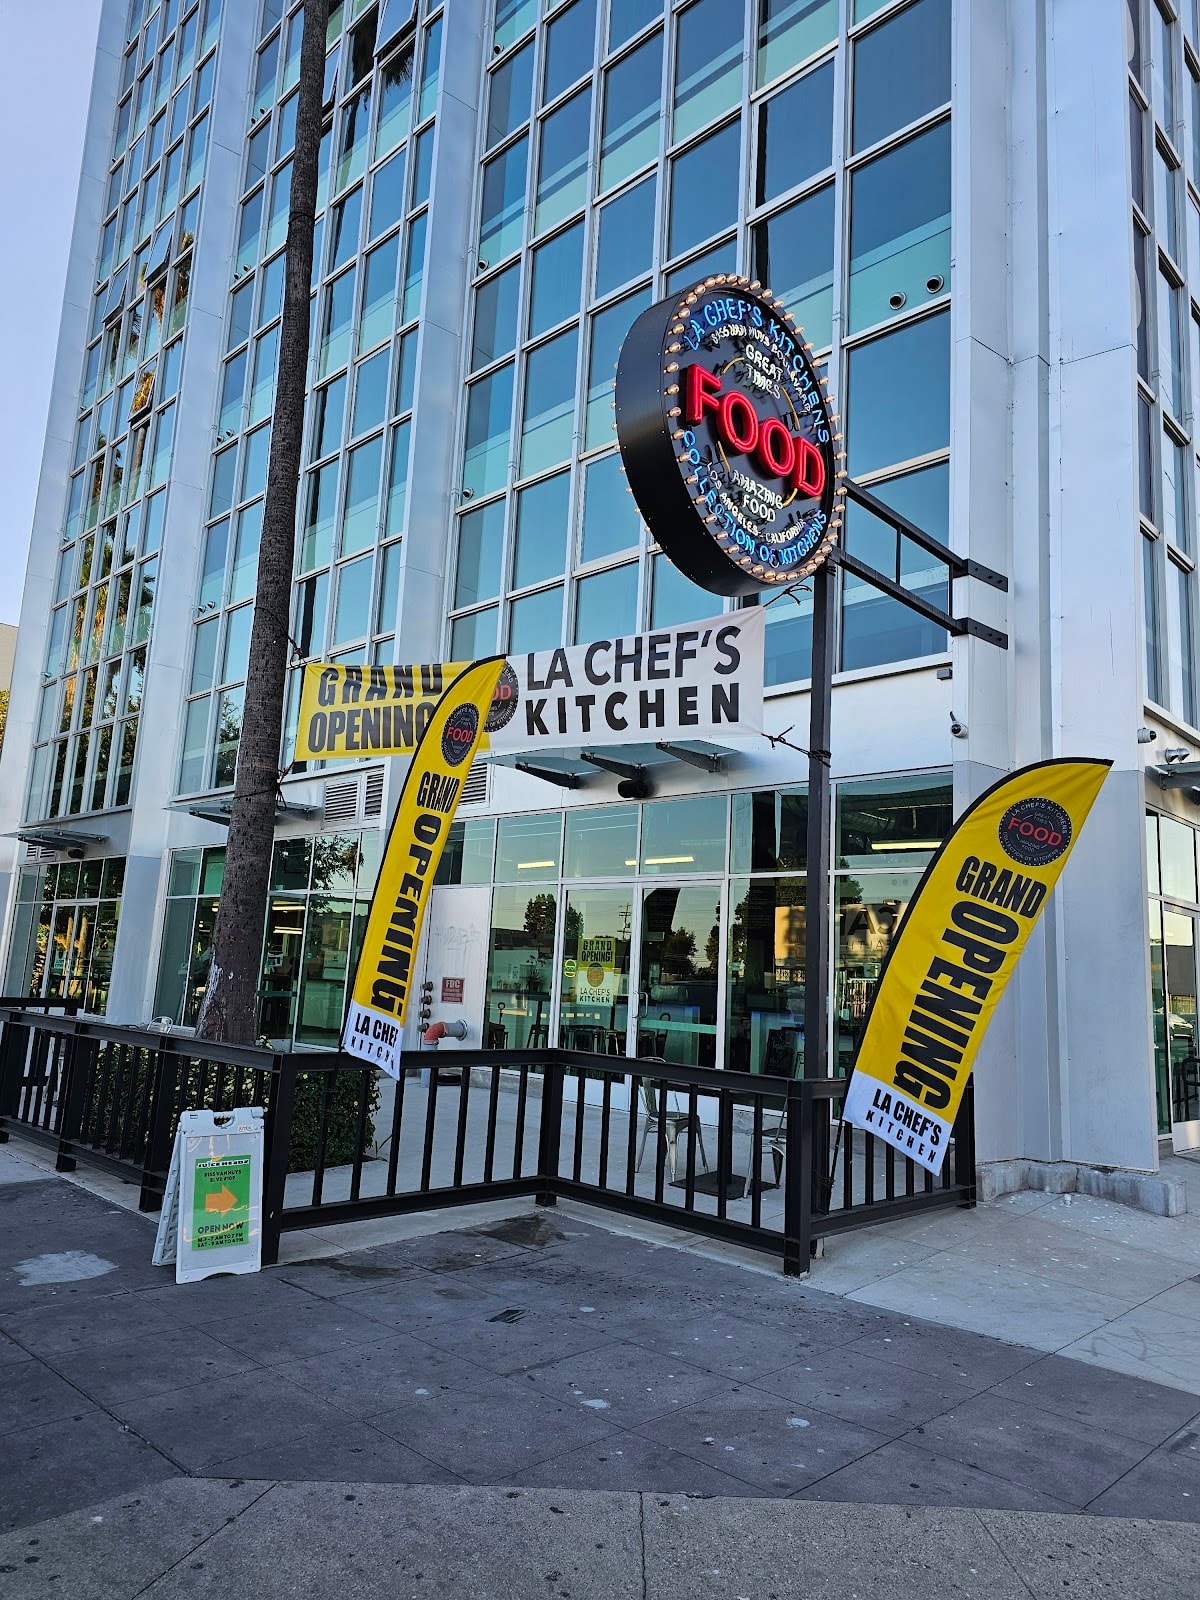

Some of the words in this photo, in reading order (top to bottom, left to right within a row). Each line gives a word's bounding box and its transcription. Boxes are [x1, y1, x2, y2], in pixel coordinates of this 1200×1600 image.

[684, 319, 705, 351] LA
[704, 298, 763, 328] CHEF'S
[769, 318, 830, 444] KITCHENS
[746, 344, 784, 382] GREAT
[746, 363, 781, 400] TIMES
[686, 363, 826, 497] FOOD
[684, 430, 756, 555] COLLECTION
[759, 545, 780, 569] OF
[779, 509, 828, 566] KITCHENS
[707, 462, 722, 490] LOS
[719, 492, 758, 536] ANGELES
[766, 518, 807, 545] CALIFORNIA
[732, 470, 784, 510] AMAZING
[743, 494, 776, 523] FOOD
[526, 651, 574, 692] LA
[584, 625, 743, 686] CHEF'S
[318, 663, 443, 707] GRAND
[525, 682, 740, 737] KITCHEN
[446, 727, 474, 743] FOOD
[415, 770, 461, 815] GRAND
[1008, 817, 1063, 846] FOOD
[1047, 806, 1068, 834] KITCHENS
[955, 854, 1048, 920] GRAND
[581, 951, 613, 962] OPENING!
[583, 940, 612, 951] GRAND
[446, 979, 461, 989] FDC
[579, 996, 610, 1004] KITCHEN
[580, 987, 587, 995] LA
[589, 988, 610, 996] CHEF'S
[355, 1012, 371, 1036] LA
[893, 900, 1021, 1110] OPENING
[865, 1109, 937, 1164] KITCHEN
[872, 1087, 891, 1112] LA
[893, 1099, 944, 1147] CHEF'S
[197, 1224, 221, 1234] OPEN
[223, 1221, 244, 1231] NOW
